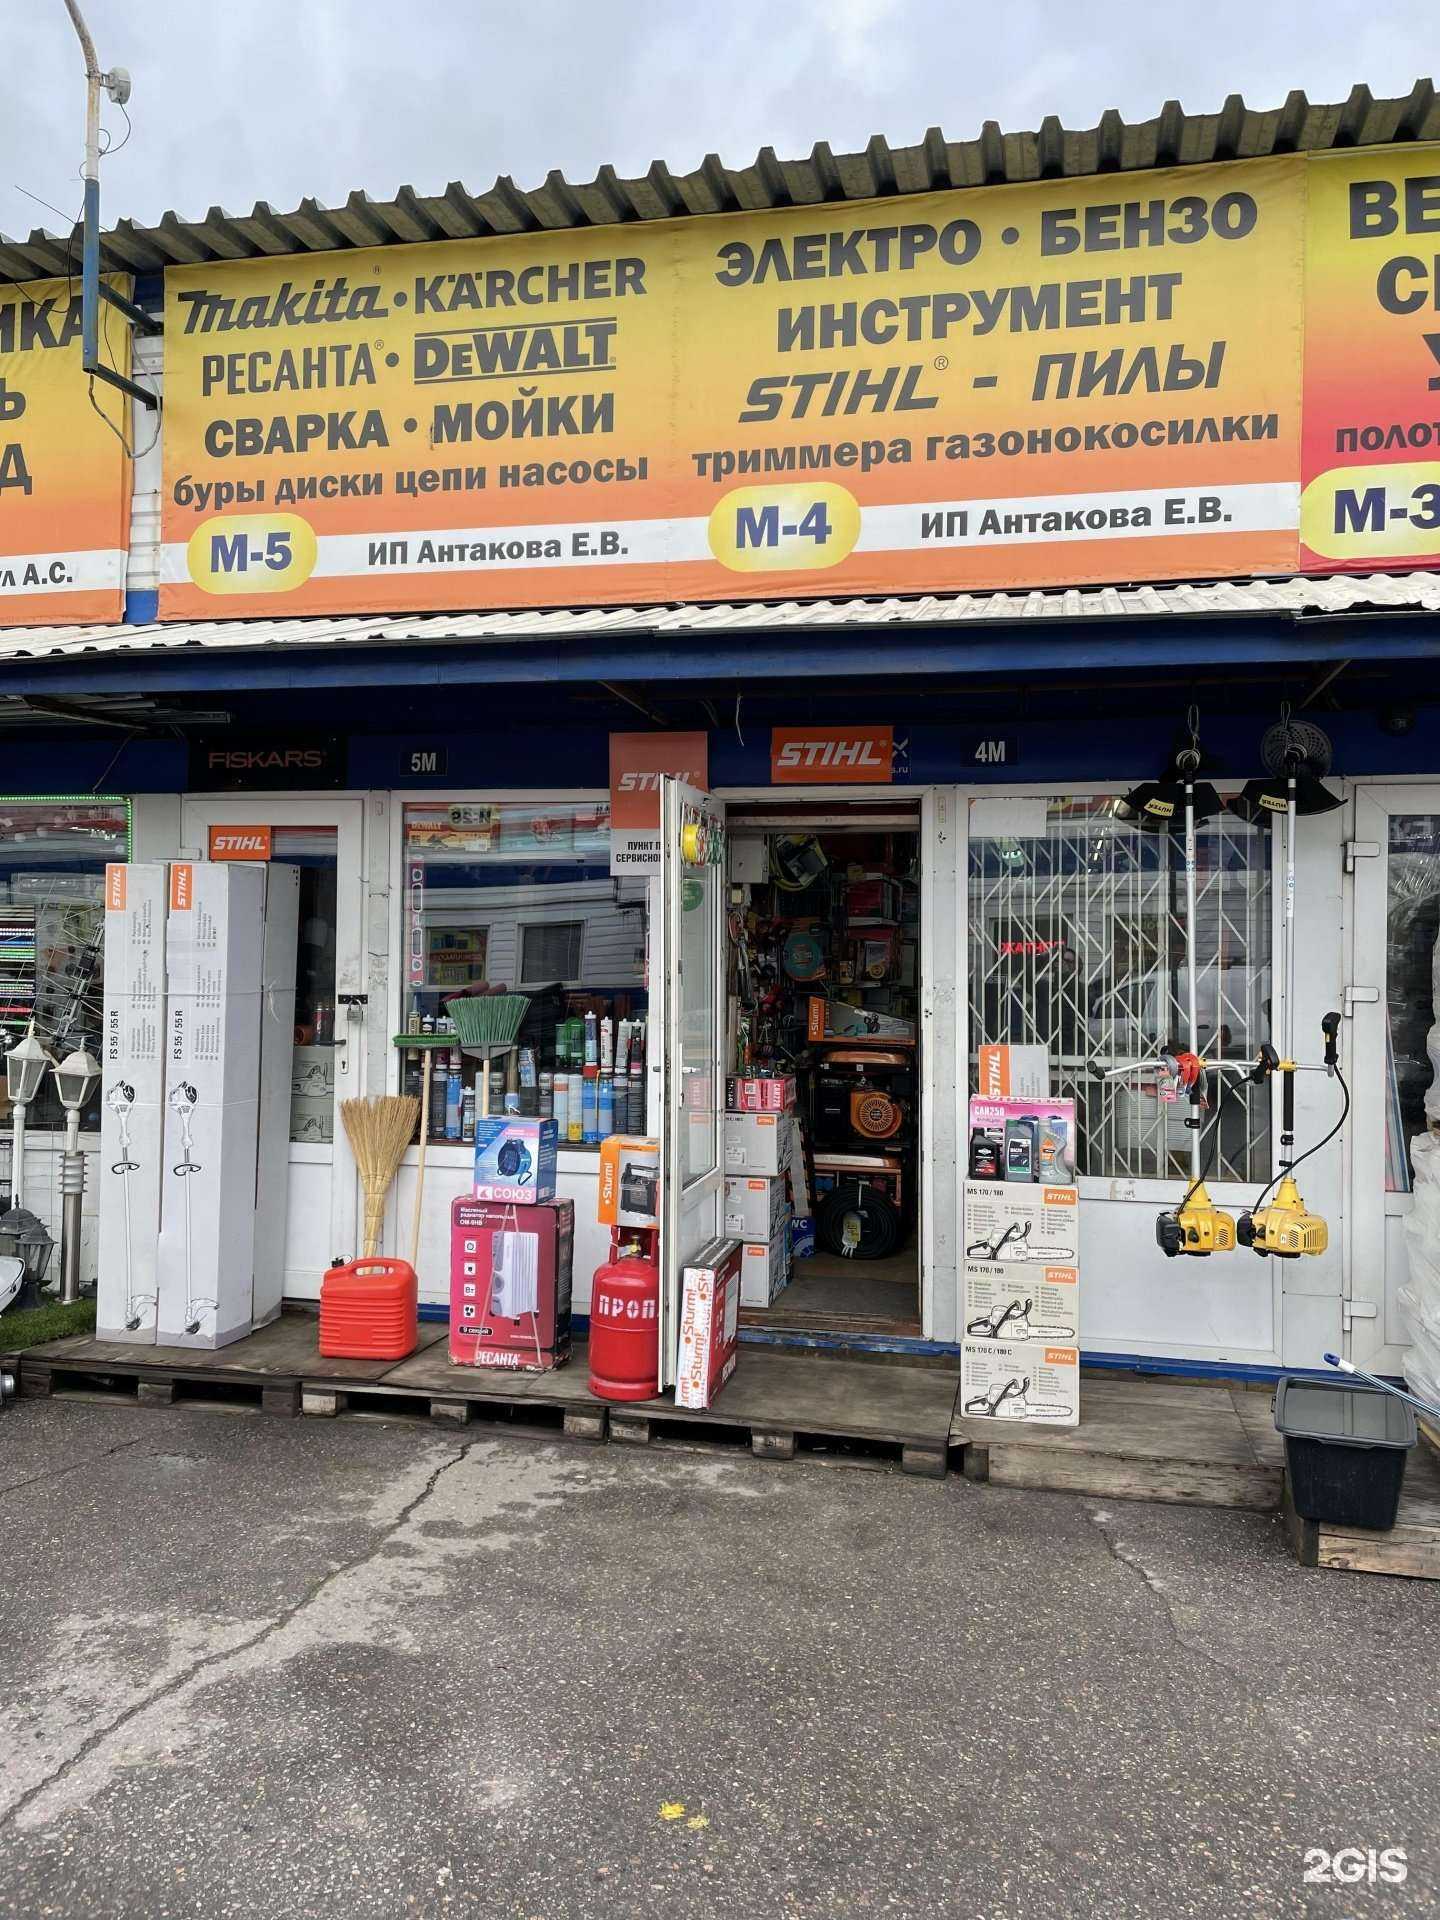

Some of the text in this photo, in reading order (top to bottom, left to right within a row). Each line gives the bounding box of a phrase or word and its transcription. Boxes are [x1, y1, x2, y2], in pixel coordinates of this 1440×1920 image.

[714, 191, 1258, 287] ЭЛЕКТРО БЕНЗО
[177, 256, 648, 336] makita KÄRCHER
[776, 272, 1183, 353] ИНСТРУМЕНТ
[202, 342, 376, 397] РЕСАНТА
[738, 365, 941, 424] STIHL
[1031, 341, 1227, 402] ПИЛЫ
[204, 386, 614, 459] СВАРКА МОЙКИ
[692, 413, 1280, 482] триммера газонокосилки
[173, 456, 649, 512] буры диски цепи насосы
[735, 501, 832, 549] М-4
[921, 496, 1233, 539] ИП Антакова Е.В.
[210, 531, 293, 574] М-5
[367, 531, 629, 567] ИП Антакова Е.В.
[22, 561, 73, 585] А.С.
[208, 750, 323, 768] FISKARS
[777, 741, 882, 767] STIHL
[213, 836, 266, 851] STIHL
[616, 853, 661, 863] СЕРВИСНО
[627, 841, 653, 851] ПУНКТ
[112, 868, 121, 908] STIHL
[177, 868, 186, 907] STIHL
[110, 1018, 119, 1029] 55
[174, 1017, 183, 1028] 55
[110, 1036, 119, 1047] 55
[110, 1048, 119, 1060] FS
[174, 1036, 183, 1047] 55
[174, 1048, 183, 1060] FS
[988, 1050, 1001, 1096] STIHL
[494, 1187, 533, 1200] СОЮЗ
[604, 1162, 613, 1200] Sturm!
[1047, 1193, 1073, 1201] STIHL
[1048, 1272, 1073, 1280] STIHL
[598, 1294, 659, 1320] ПРОП
[683, 1289, 697, 1336] Sturm!
[690, 1328, 705, 1380] Sturm!
[1047, 1353, 1073, 1361] STIHL
